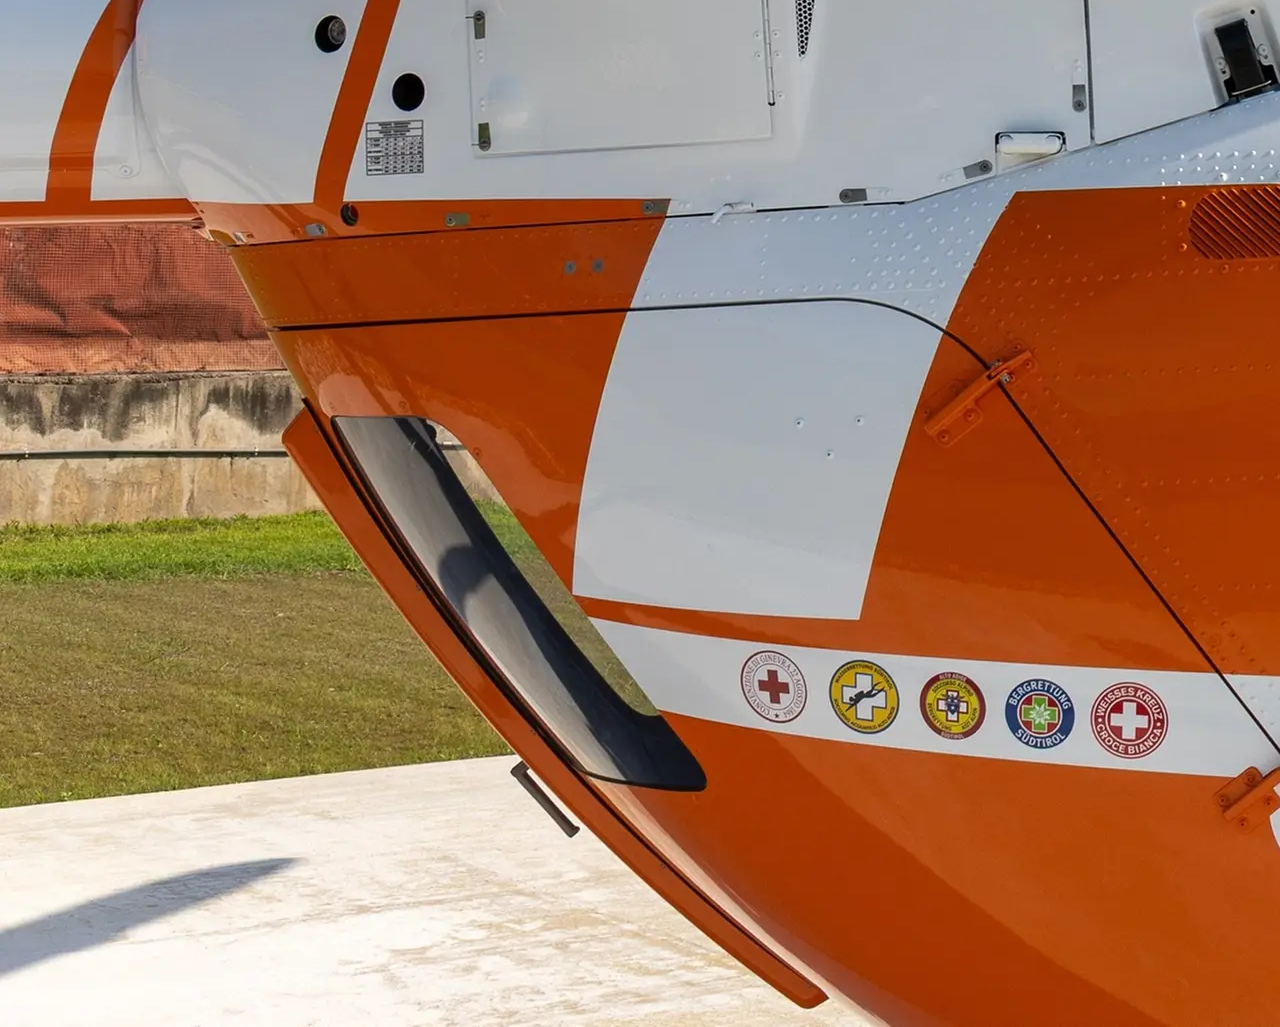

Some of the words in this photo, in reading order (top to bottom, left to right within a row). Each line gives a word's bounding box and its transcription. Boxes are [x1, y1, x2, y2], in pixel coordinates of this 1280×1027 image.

[759, 654, 792, 671] GINEVRA
[1008, 680, 1072, 710] BERGRETTUNG
[1096, 687, 1135, 716] WEISSES
[1136, 689, 1163, 720] KREUZ
[1096, 724, 1126, 753] CROCE
[1127, 728, 1162, 754] BIANCA
